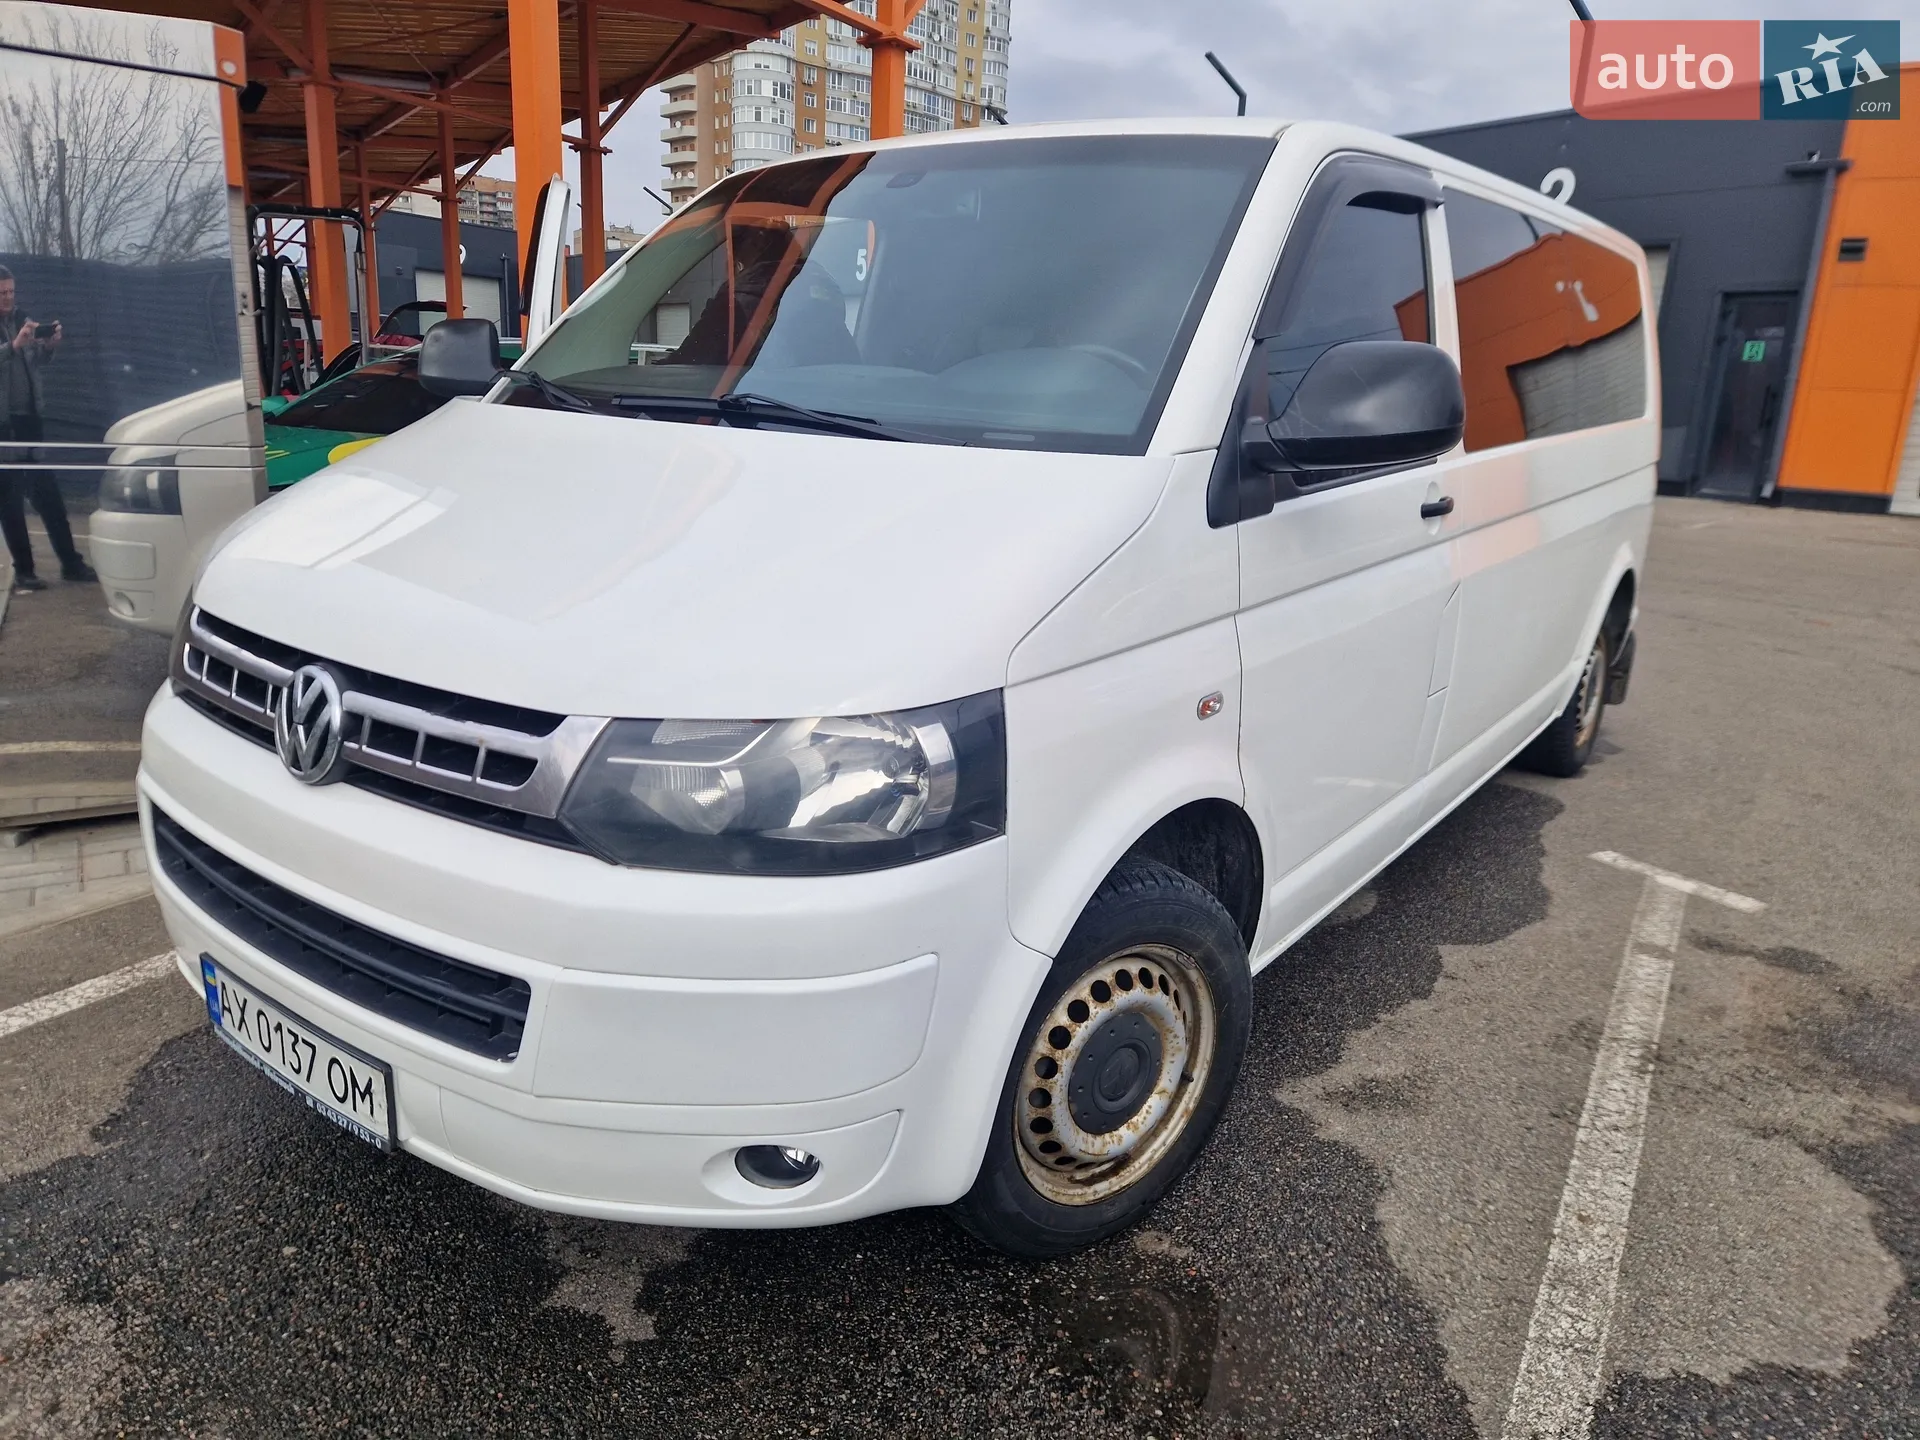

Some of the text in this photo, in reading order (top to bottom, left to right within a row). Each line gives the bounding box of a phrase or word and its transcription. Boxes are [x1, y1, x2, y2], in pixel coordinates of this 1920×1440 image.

[855, 248, 867, 282] 5
[220, 980, 253, 1042] AX
[256, 1008, 317, 1084] 0137
[327, 1055, 375, 1118] OM
